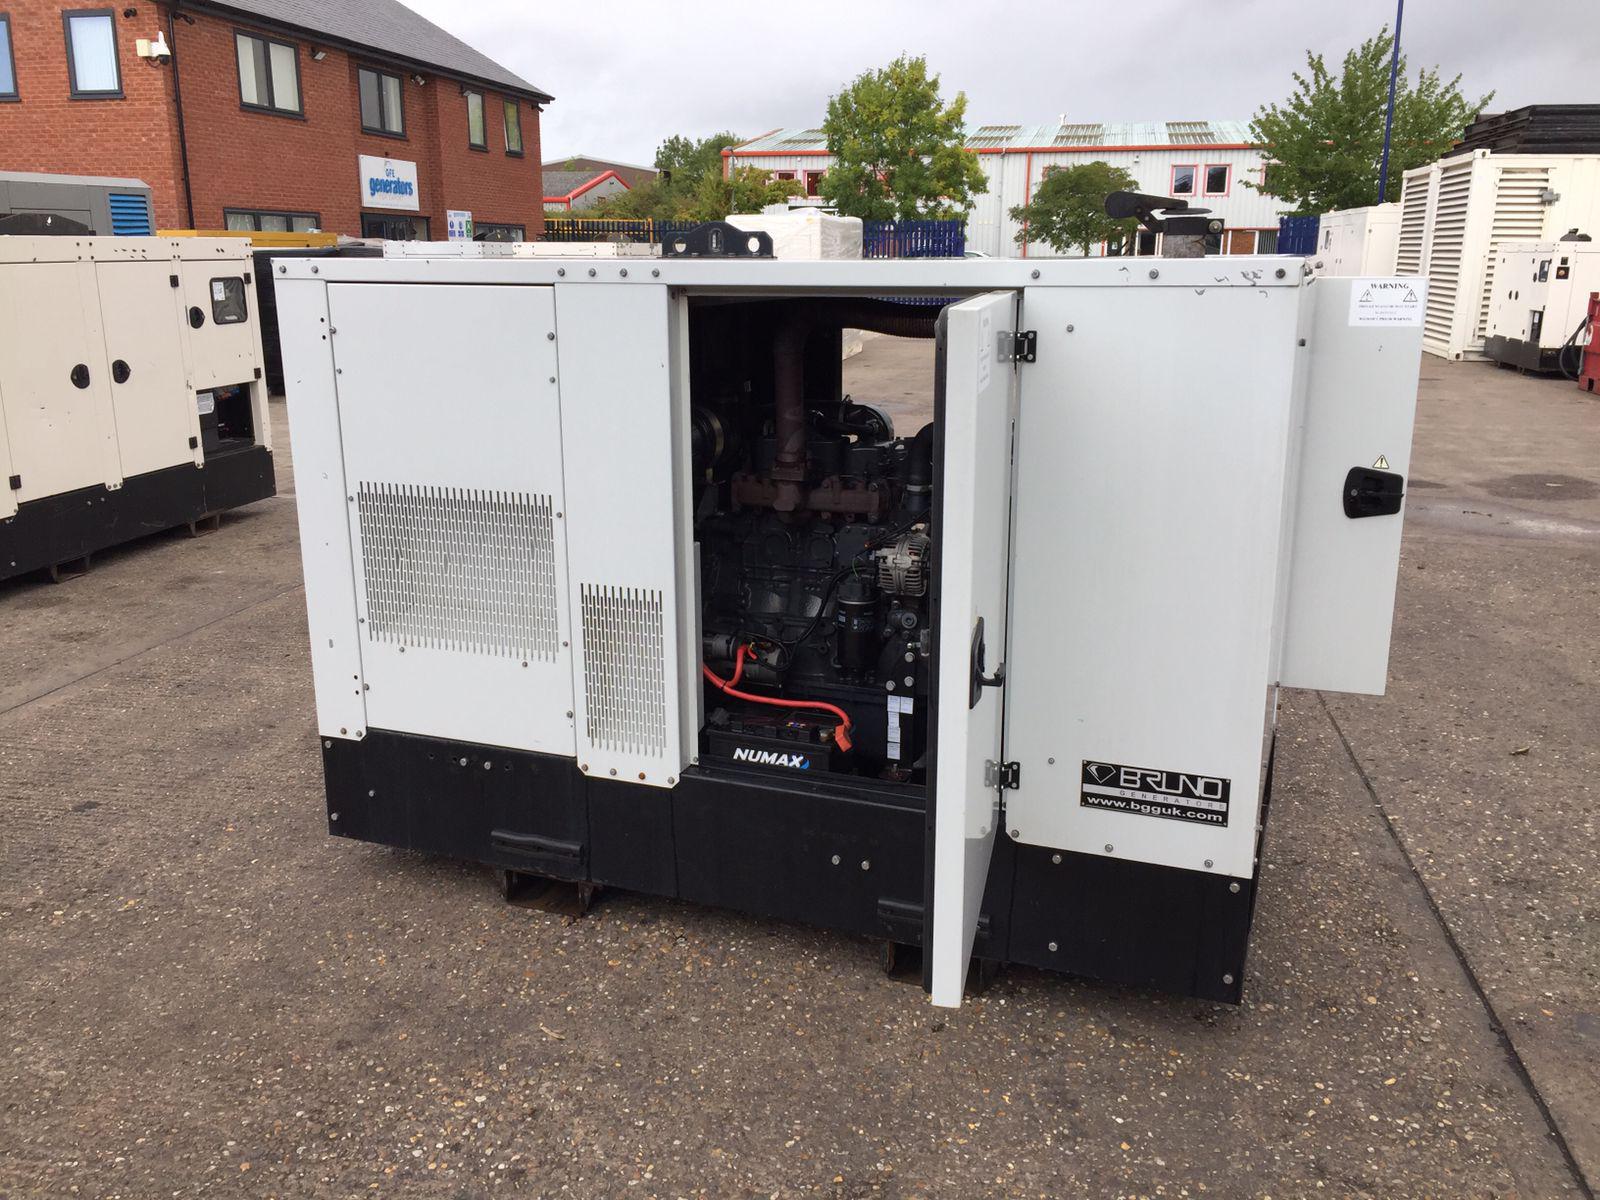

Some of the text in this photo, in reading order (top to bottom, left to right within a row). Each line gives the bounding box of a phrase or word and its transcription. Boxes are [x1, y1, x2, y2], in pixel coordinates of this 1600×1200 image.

[369, 177, 414, 197] generators
[733, 747, 804, 768] NUMAX
[1119, 767, 1223, 800] BRUNO
[1086, 796, 1223, 822] www.bgguk.com
[1119, 790, 1226, 810] GENERATORS
